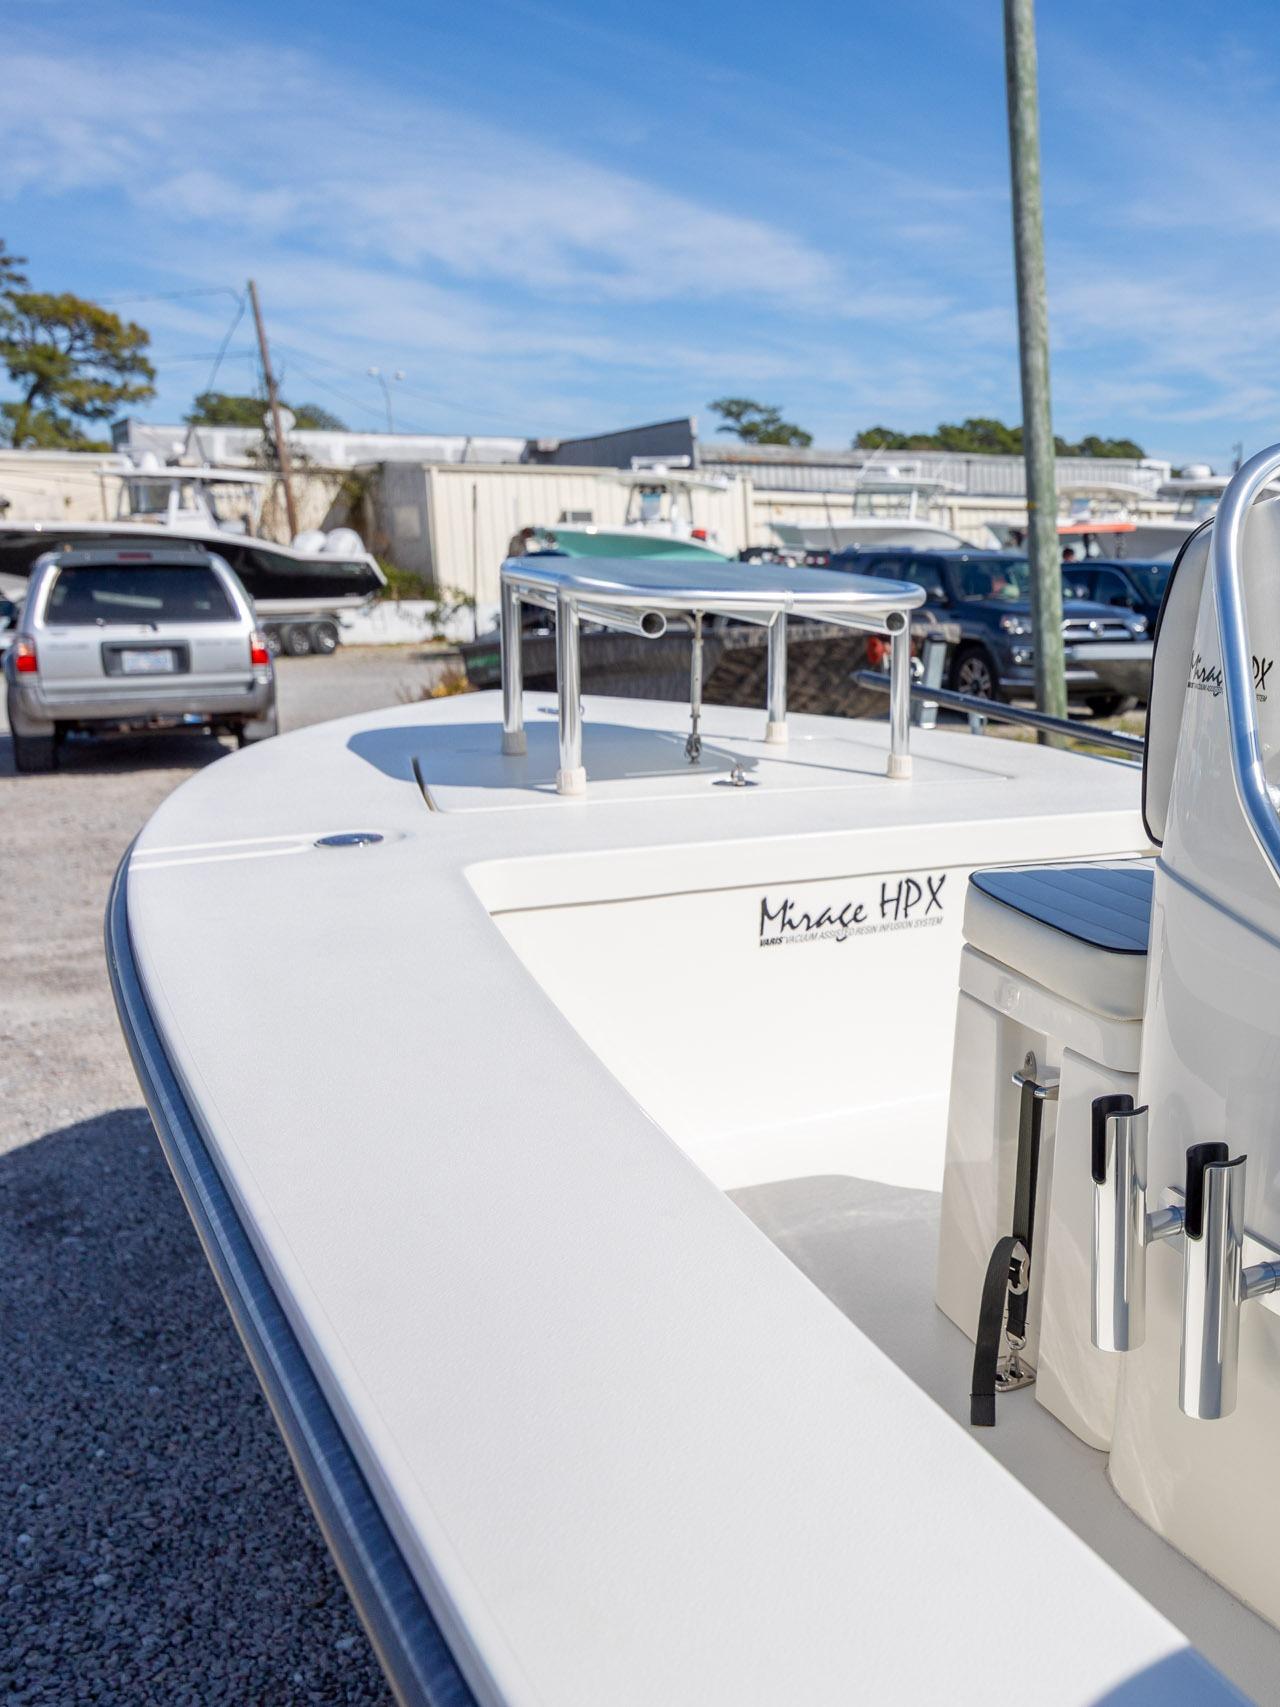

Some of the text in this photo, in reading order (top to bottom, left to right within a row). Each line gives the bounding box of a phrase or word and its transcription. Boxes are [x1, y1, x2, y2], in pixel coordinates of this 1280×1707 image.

[1252, 655, 1273, 690] PX
[760, 874, 946, 941] Mirage HPX
[914, 916, 943, 929] SYSTEM
